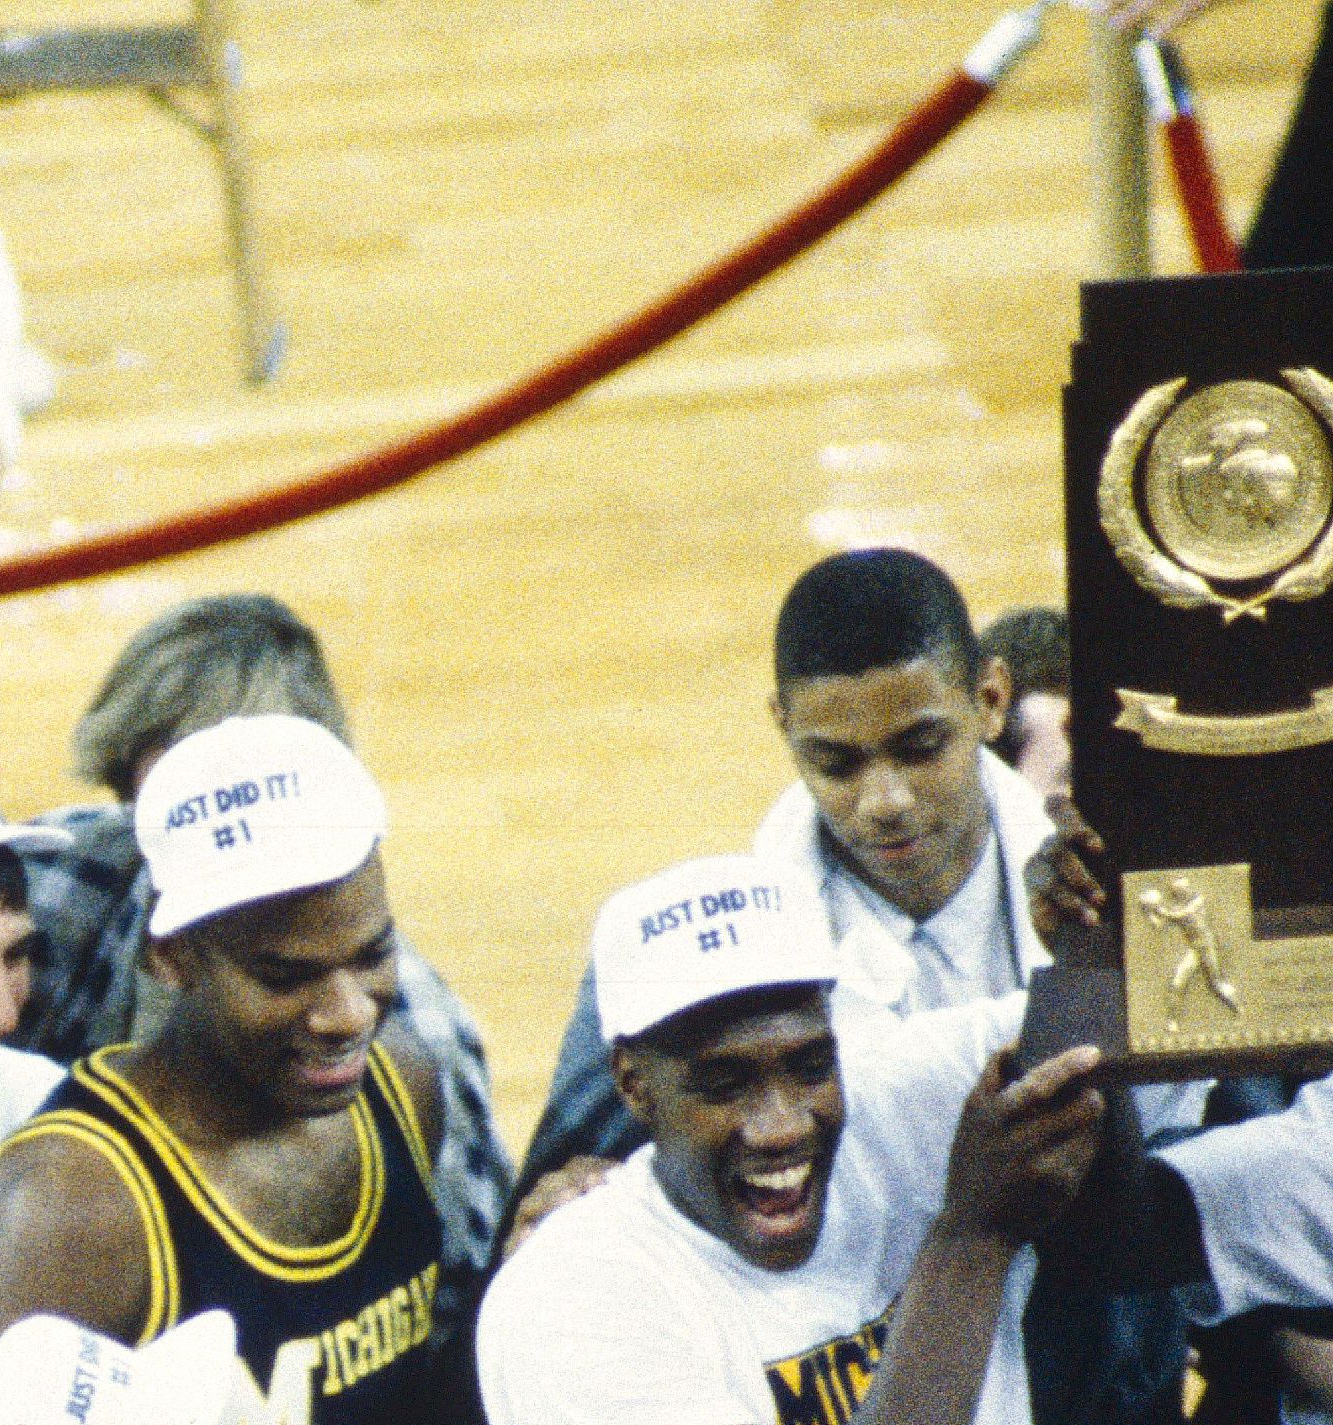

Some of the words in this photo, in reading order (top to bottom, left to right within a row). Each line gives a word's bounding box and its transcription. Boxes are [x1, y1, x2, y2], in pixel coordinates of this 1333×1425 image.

[265, 770, 301, 801] IT!
[212, 817, 252, 850] #1
[640, 899, 694, 945] JUST
[698, 886, 747, 918] DID
[695, 921, 740, 952] #1
